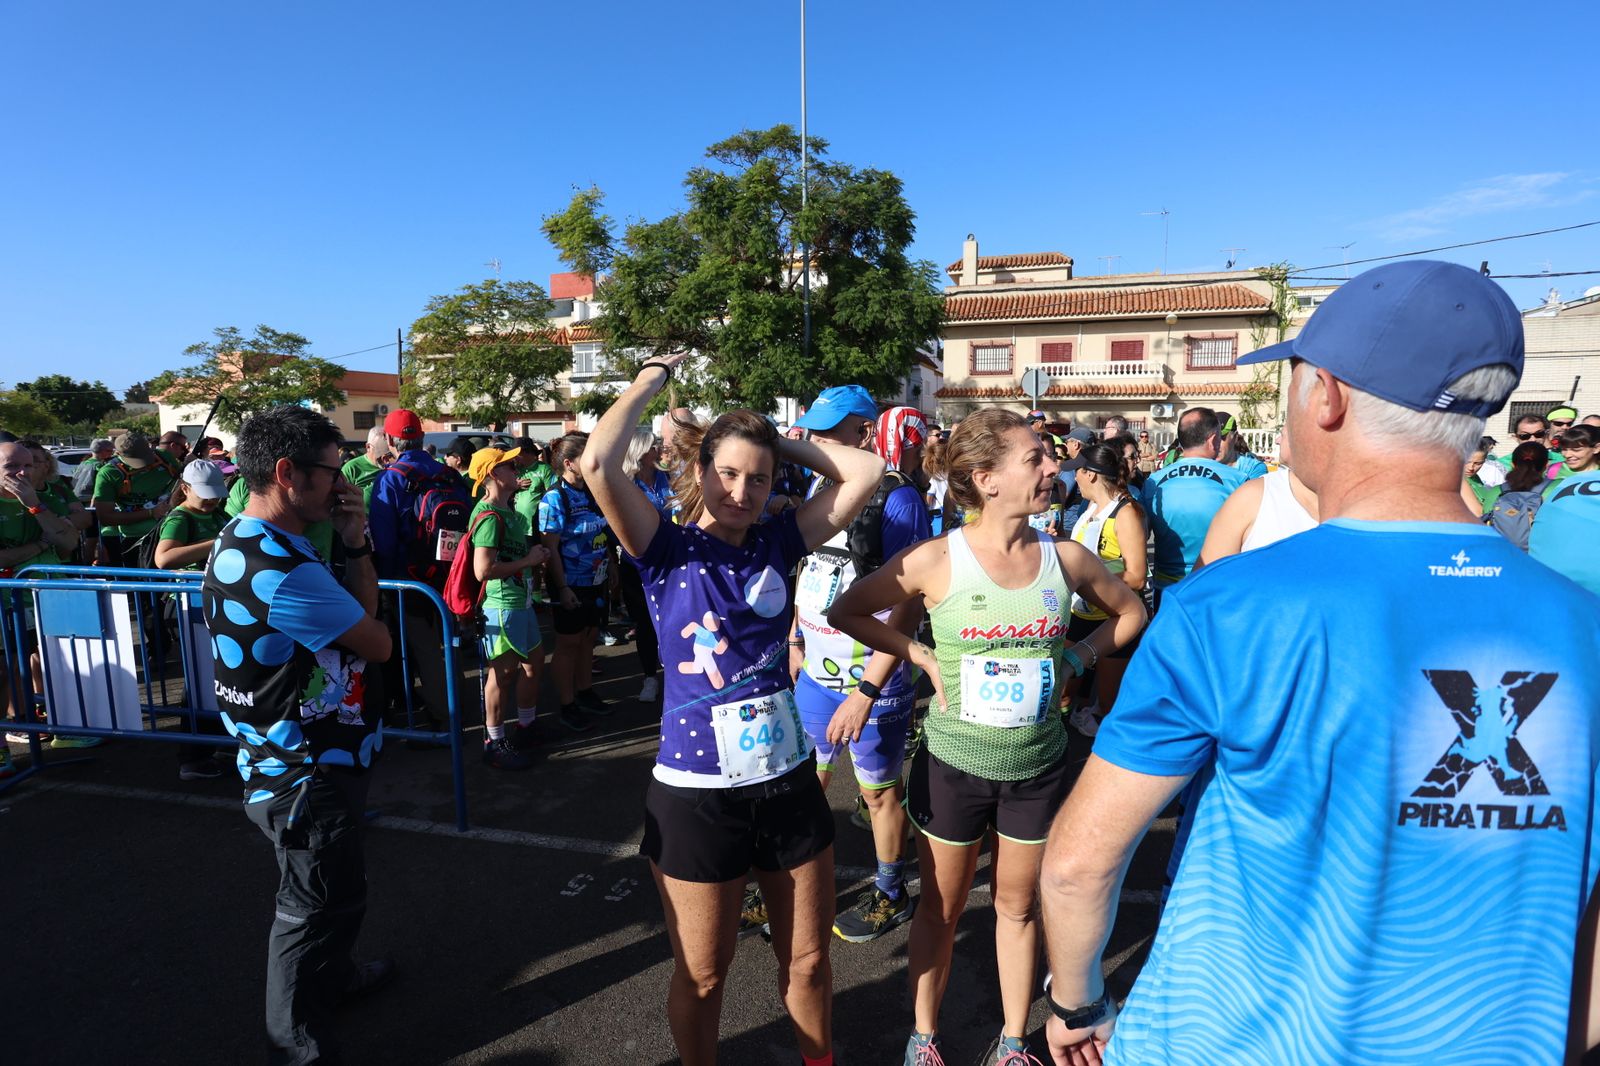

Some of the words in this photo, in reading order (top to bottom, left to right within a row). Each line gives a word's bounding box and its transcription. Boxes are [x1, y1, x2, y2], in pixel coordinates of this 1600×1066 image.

[1428, 565, 1503, 578] TEAMERGY
[960, 616, 1068, 640] maratón
[986, 641, 1053, 651] JEREZ
[979, 681, 1025, 703] 698
[738, 720, 785, 752] 646
[1397, 802, 1567, 832] PIRATILLA
